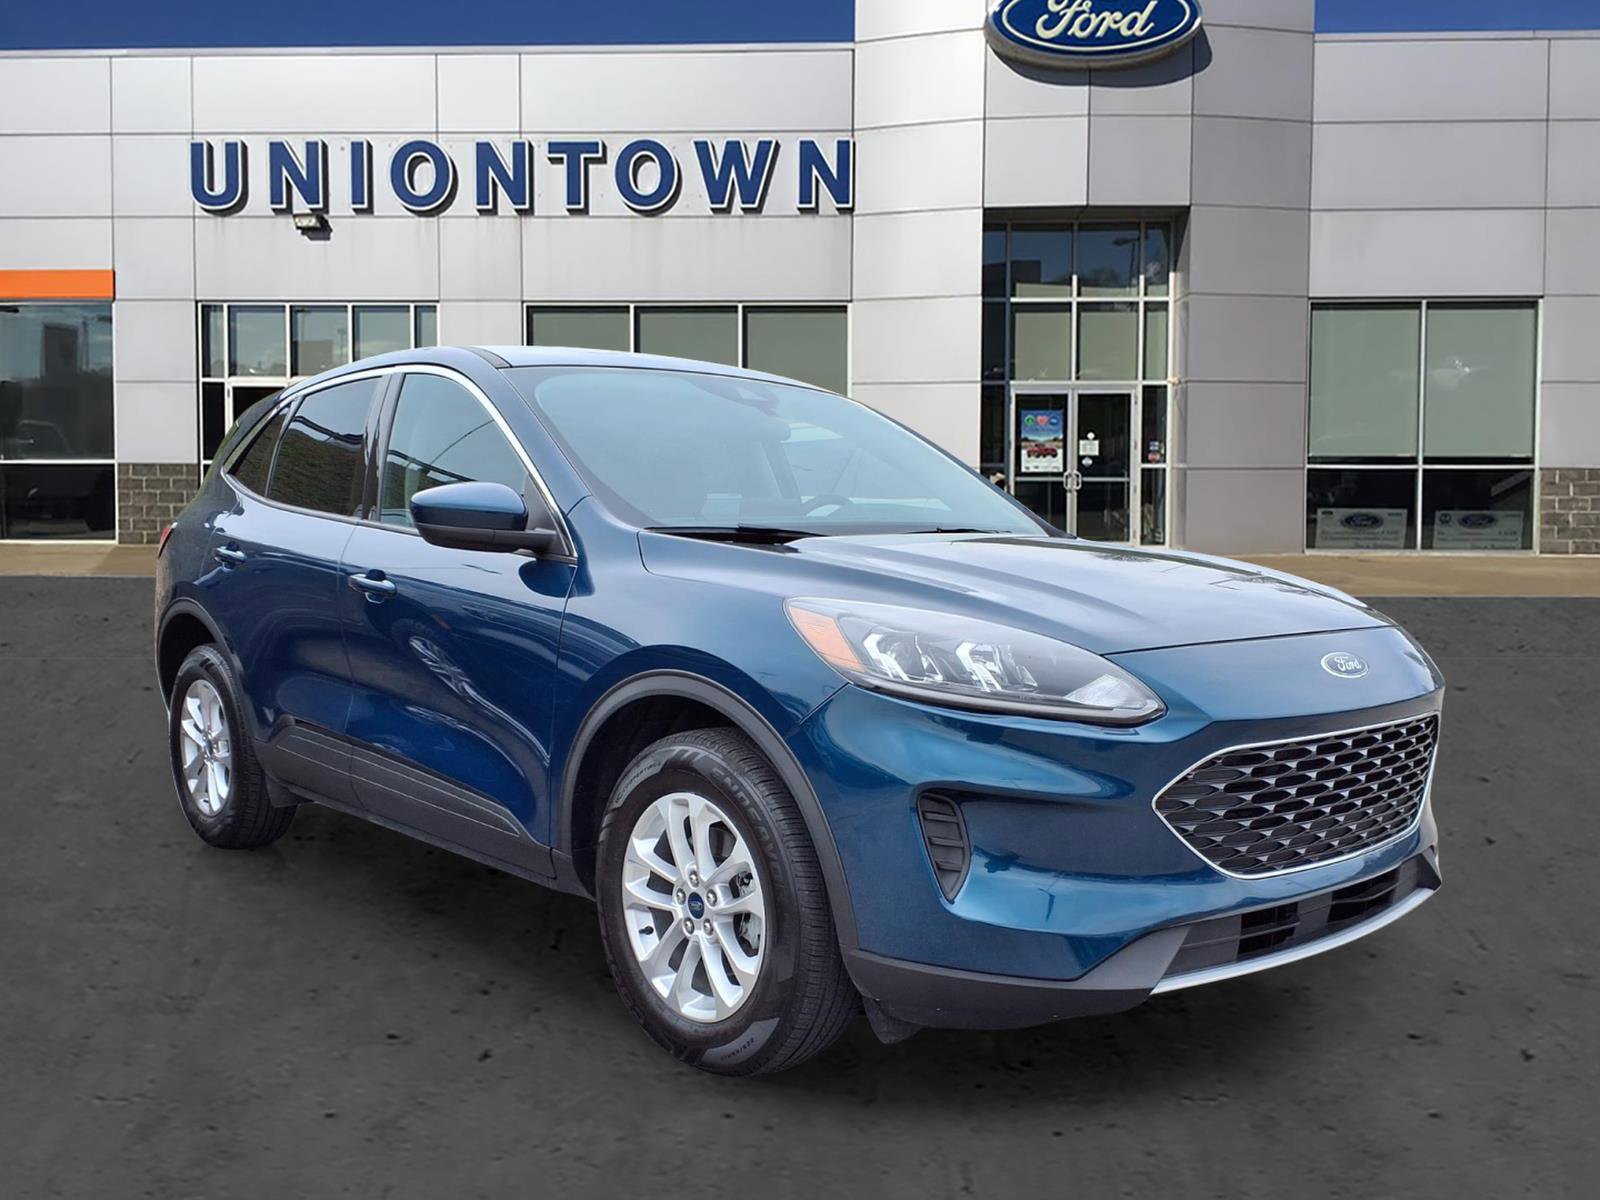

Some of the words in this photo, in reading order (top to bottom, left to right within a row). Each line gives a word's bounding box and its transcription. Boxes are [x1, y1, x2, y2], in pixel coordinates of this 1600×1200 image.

[1035, 0, 1157, 39] Ford
[190, 139, 855, 214] UNIONTOWN
[1334, 656, 1362, 671] Ford
